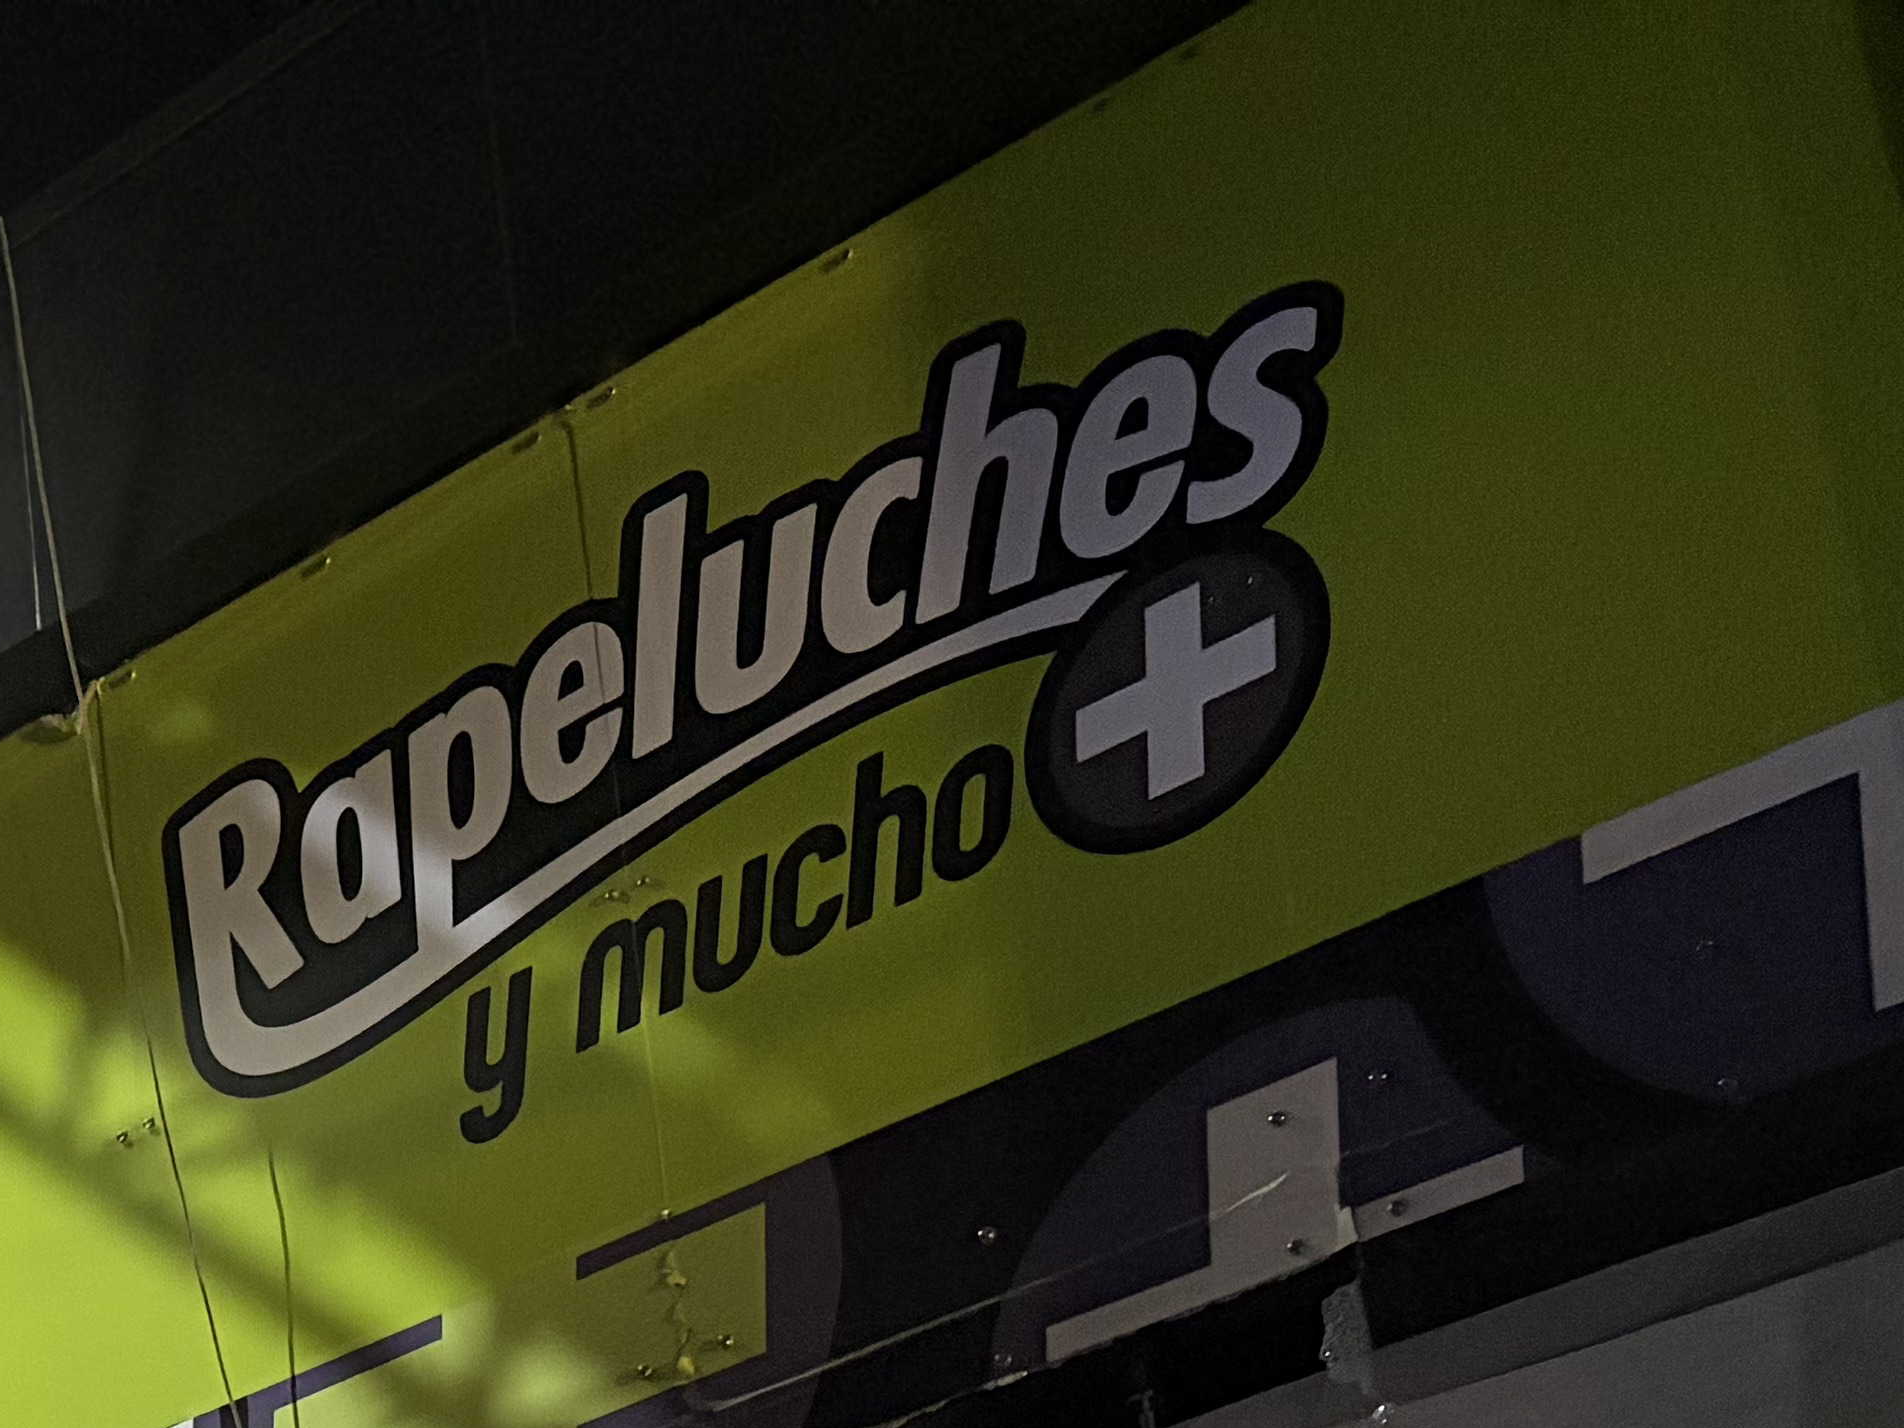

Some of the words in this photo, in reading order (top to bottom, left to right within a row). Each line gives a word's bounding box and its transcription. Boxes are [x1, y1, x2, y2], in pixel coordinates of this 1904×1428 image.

[172, 292, 1332, 1010] Rapeluches
[459, 965, 534, 1144] y
[577, 744, 1016, 1057] mucho
